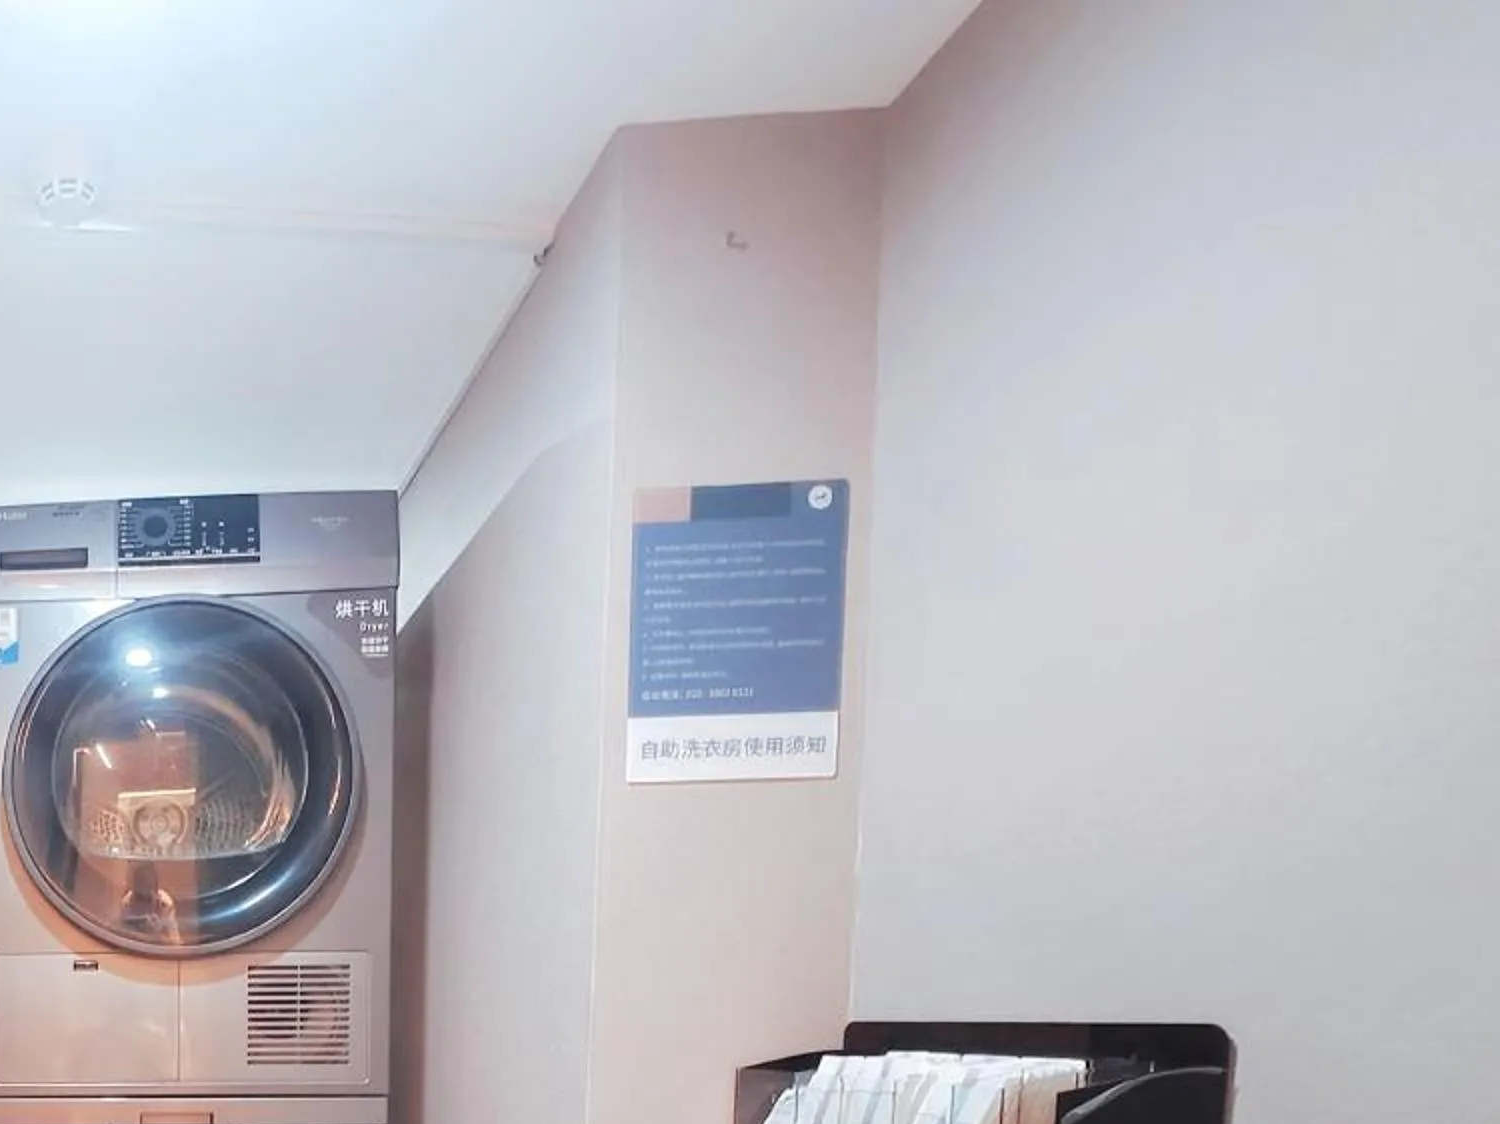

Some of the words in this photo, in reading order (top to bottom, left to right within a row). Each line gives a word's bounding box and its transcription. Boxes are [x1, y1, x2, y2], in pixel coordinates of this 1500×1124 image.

[335, 598, 389, 619] 烘干机
[640, 736, 827, 761] 自助洗衣房使用须知
